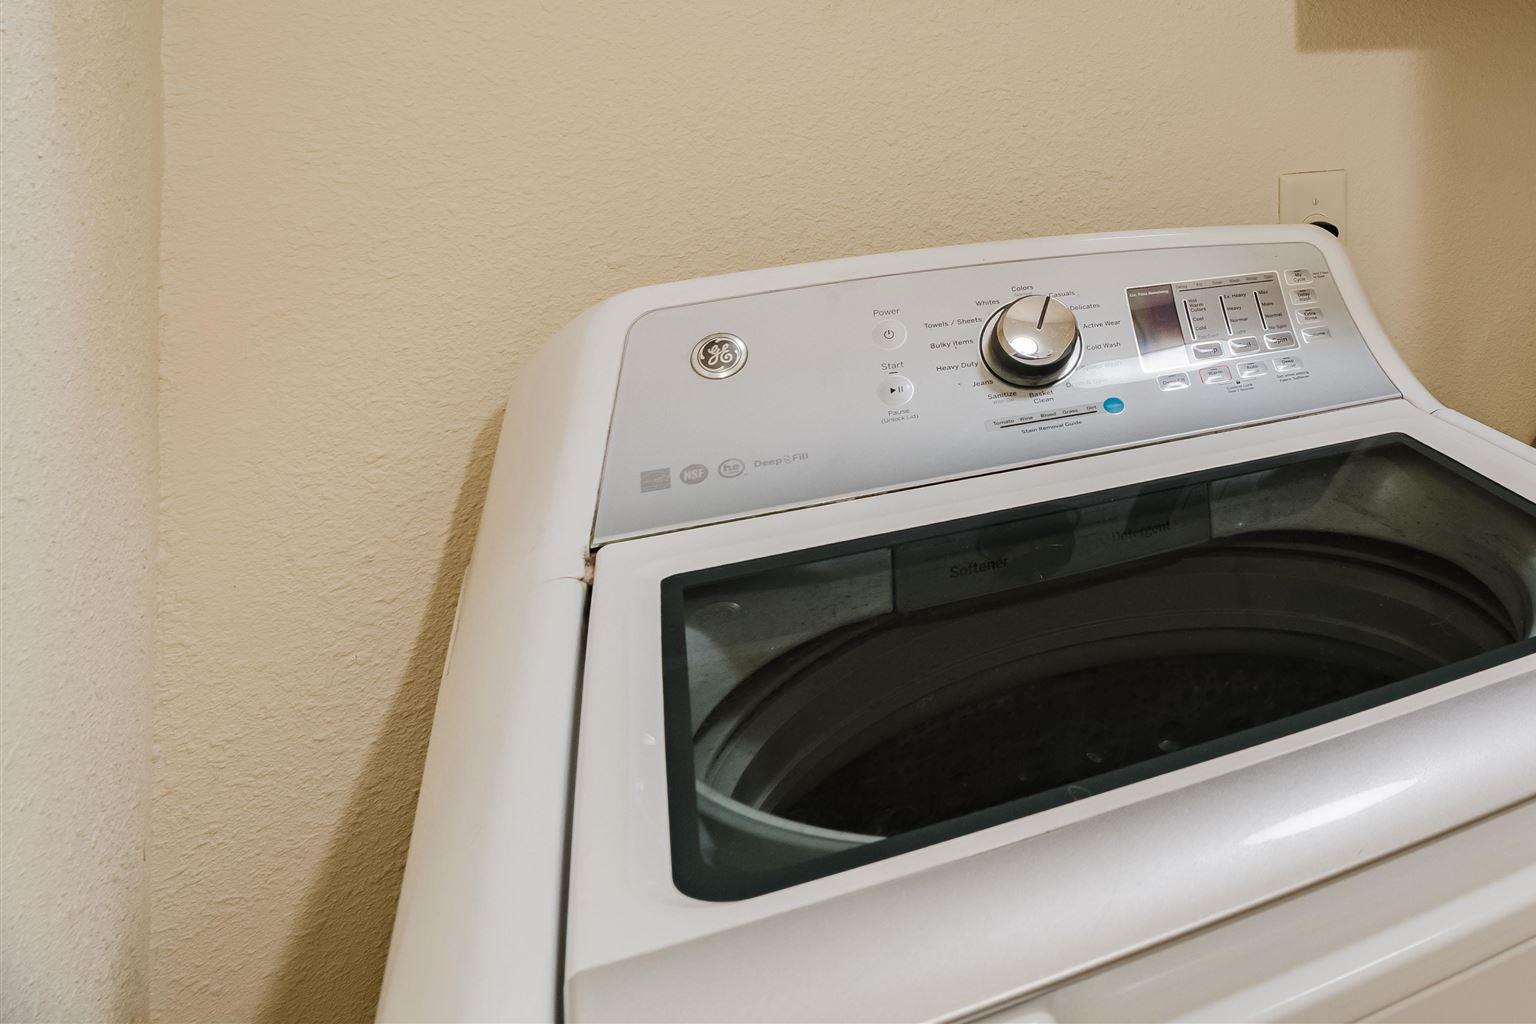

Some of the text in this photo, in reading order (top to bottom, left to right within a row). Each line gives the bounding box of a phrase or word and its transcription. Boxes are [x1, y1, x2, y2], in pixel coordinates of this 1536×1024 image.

[1011, 284, 1034, 292] Colors
[1049, 290, 1075, 299] Casuals
[975, 299, 1000, 307] Whites
[1069, 302, 1101, 311] Delicates
[872, 308, 900, 317] Power
[924, 321, 949, 329] Towels
[957, 316, 983, 326] Sheets
[929, 338, 974, 350] Bulky Items
[1086, 341, 1122, 351] Cold Wash
[881, 360, 905, 370] Start
[936, 360, 979, 372] Heavy Duty
[972, 379, 994, 387] Jeans
[987, 391, 1017, 400] Sanitize
[1029, 389, 1054, 398] Basket
[1033, 396, 1055, 404] Clean
[880, 415, 905, 425] (Unlock
[1038, 423, 1064, 431] Removal
[682, 467, 706, 482] NSF
[753, 457, 783, 468] Deep
[791, 452, 809, 462] Fill
[950, 557, 1009, 578] Softener
